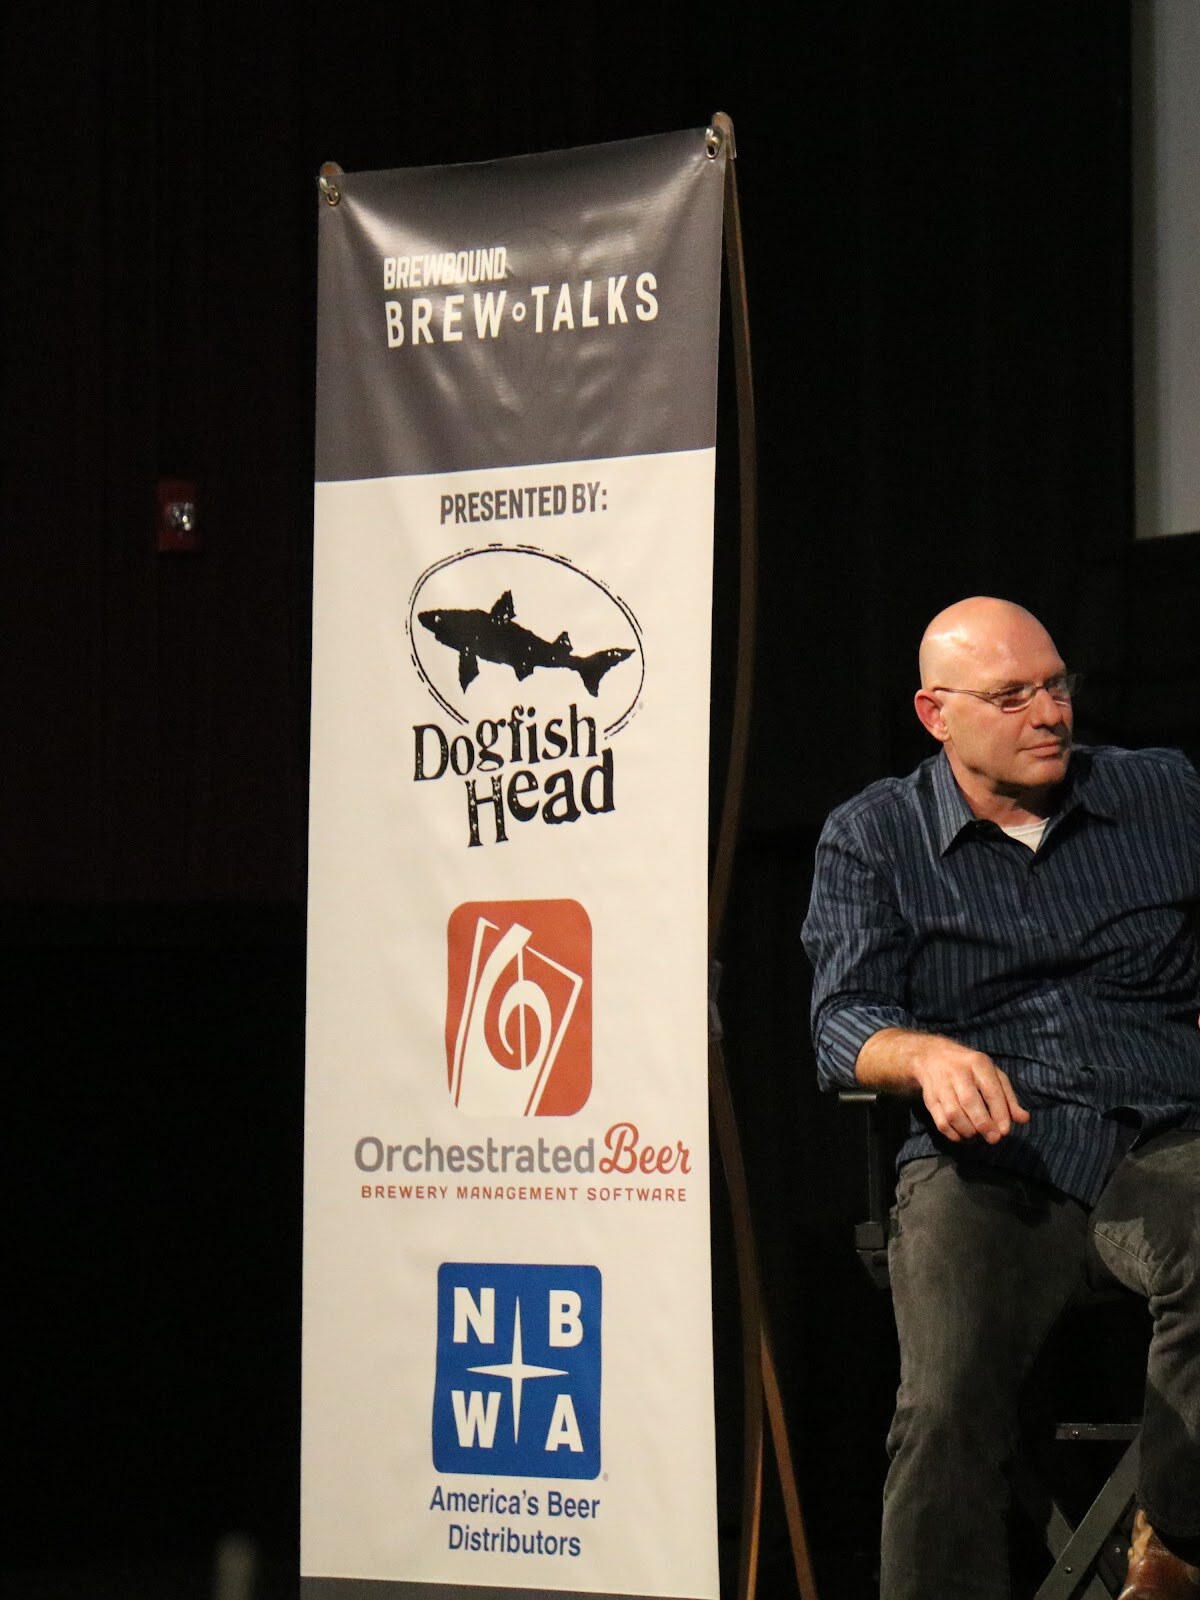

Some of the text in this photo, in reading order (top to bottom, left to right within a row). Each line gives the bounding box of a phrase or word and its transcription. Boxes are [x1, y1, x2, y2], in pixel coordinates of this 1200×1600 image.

[383, 246, 507, 290] BREWBOUND
[385, 272, 659, 348] BREW TALKS
[440, 481, 608, 525] PRESENTED BY:
[412, 703, 599, 781] Dogfish
[464, 747, 616, 848] Head
[354, 1122, 692, 1176] Orchestrated Beer
[361, 1185, 687, 1202] BREWERY MANAGEMENT SOFTWARE
[429, 1485, 600, 1519] America's Beer
[447, 1524, 581, 1557] Distributors
